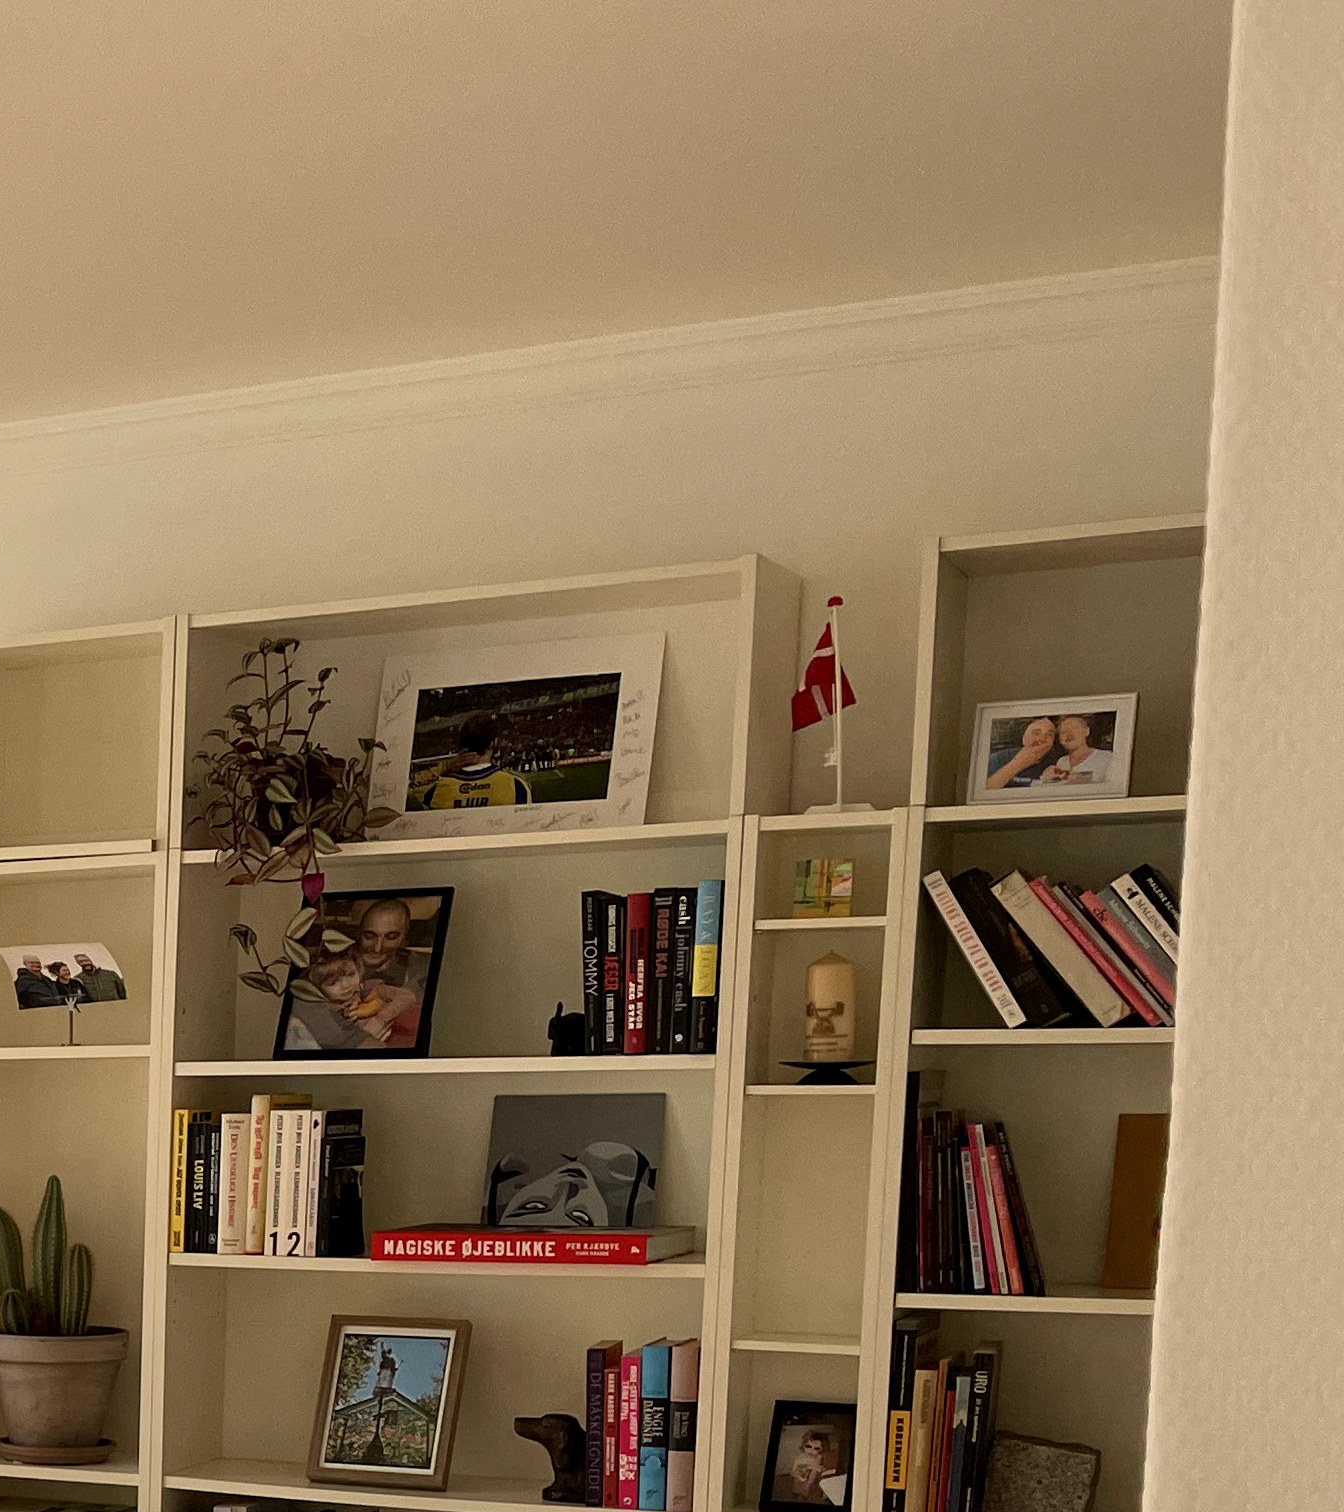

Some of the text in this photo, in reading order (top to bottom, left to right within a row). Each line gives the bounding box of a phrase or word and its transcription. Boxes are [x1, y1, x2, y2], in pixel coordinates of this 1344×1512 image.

[1136, 899, 1163, 931] MALENE
[583, 937, 599, 997] TOMMY
[674, 895, 691, 1013] cash johnny cash
[192, 1159, 205, 1210] LOUIS LIV
[269, 1231, 278, 1257] 1
[287, 1231, 301, 1257] 2
[383, 1237, 557, 1259] MAGISKE ØJEBLIKKE
[974, 1370, 989, 1394] URO
[642, 1399, 654, 1444] DÆMONER
[653, 1406, 665, 1438] ENGLE
